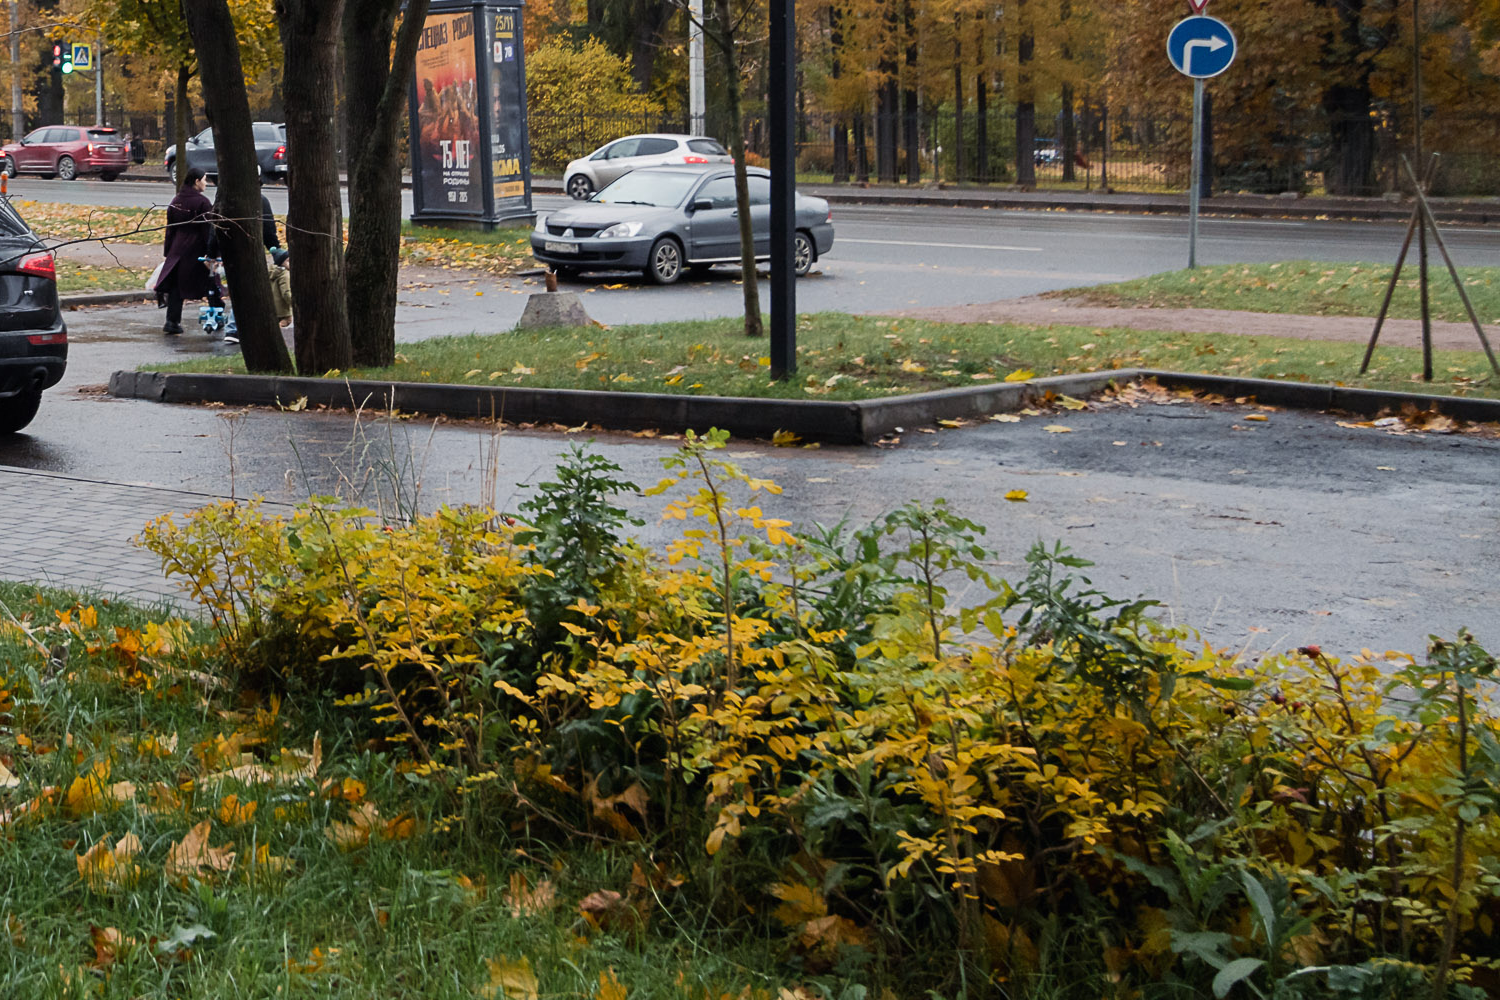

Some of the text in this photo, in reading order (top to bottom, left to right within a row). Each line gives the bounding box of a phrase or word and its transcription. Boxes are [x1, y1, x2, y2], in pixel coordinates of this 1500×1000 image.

[495, 15, 513, 31] 25/11
[417, 21, 448, 52] ПЕЦНАЗ
[455, 140, 470, 169] ЛЕТ
[443, 178, 470, 186] РОДИНЫ
